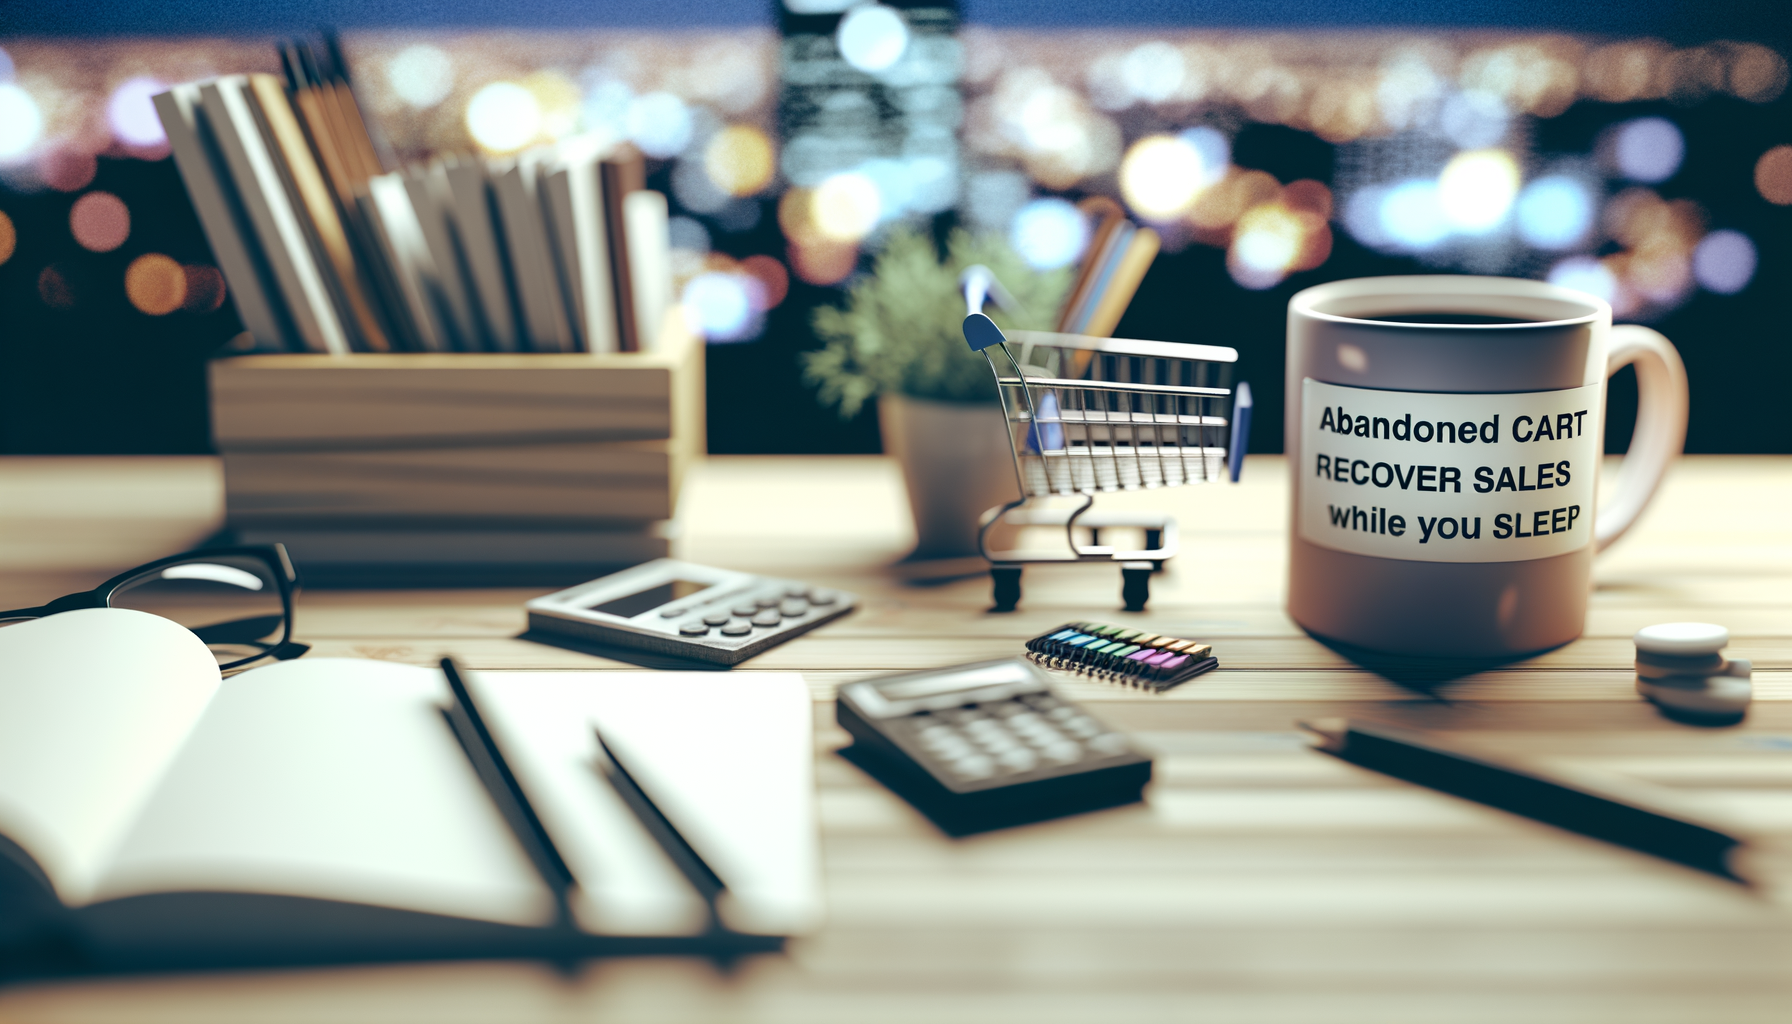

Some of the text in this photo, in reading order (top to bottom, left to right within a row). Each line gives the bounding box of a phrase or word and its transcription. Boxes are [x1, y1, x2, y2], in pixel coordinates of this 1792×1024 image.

[1319, 405, 1588, 444] Abandoned CART
[1315, 453, 1571, 494] RECOVER SALES
[1328, 504, 1581, 544] while you SLEEP
